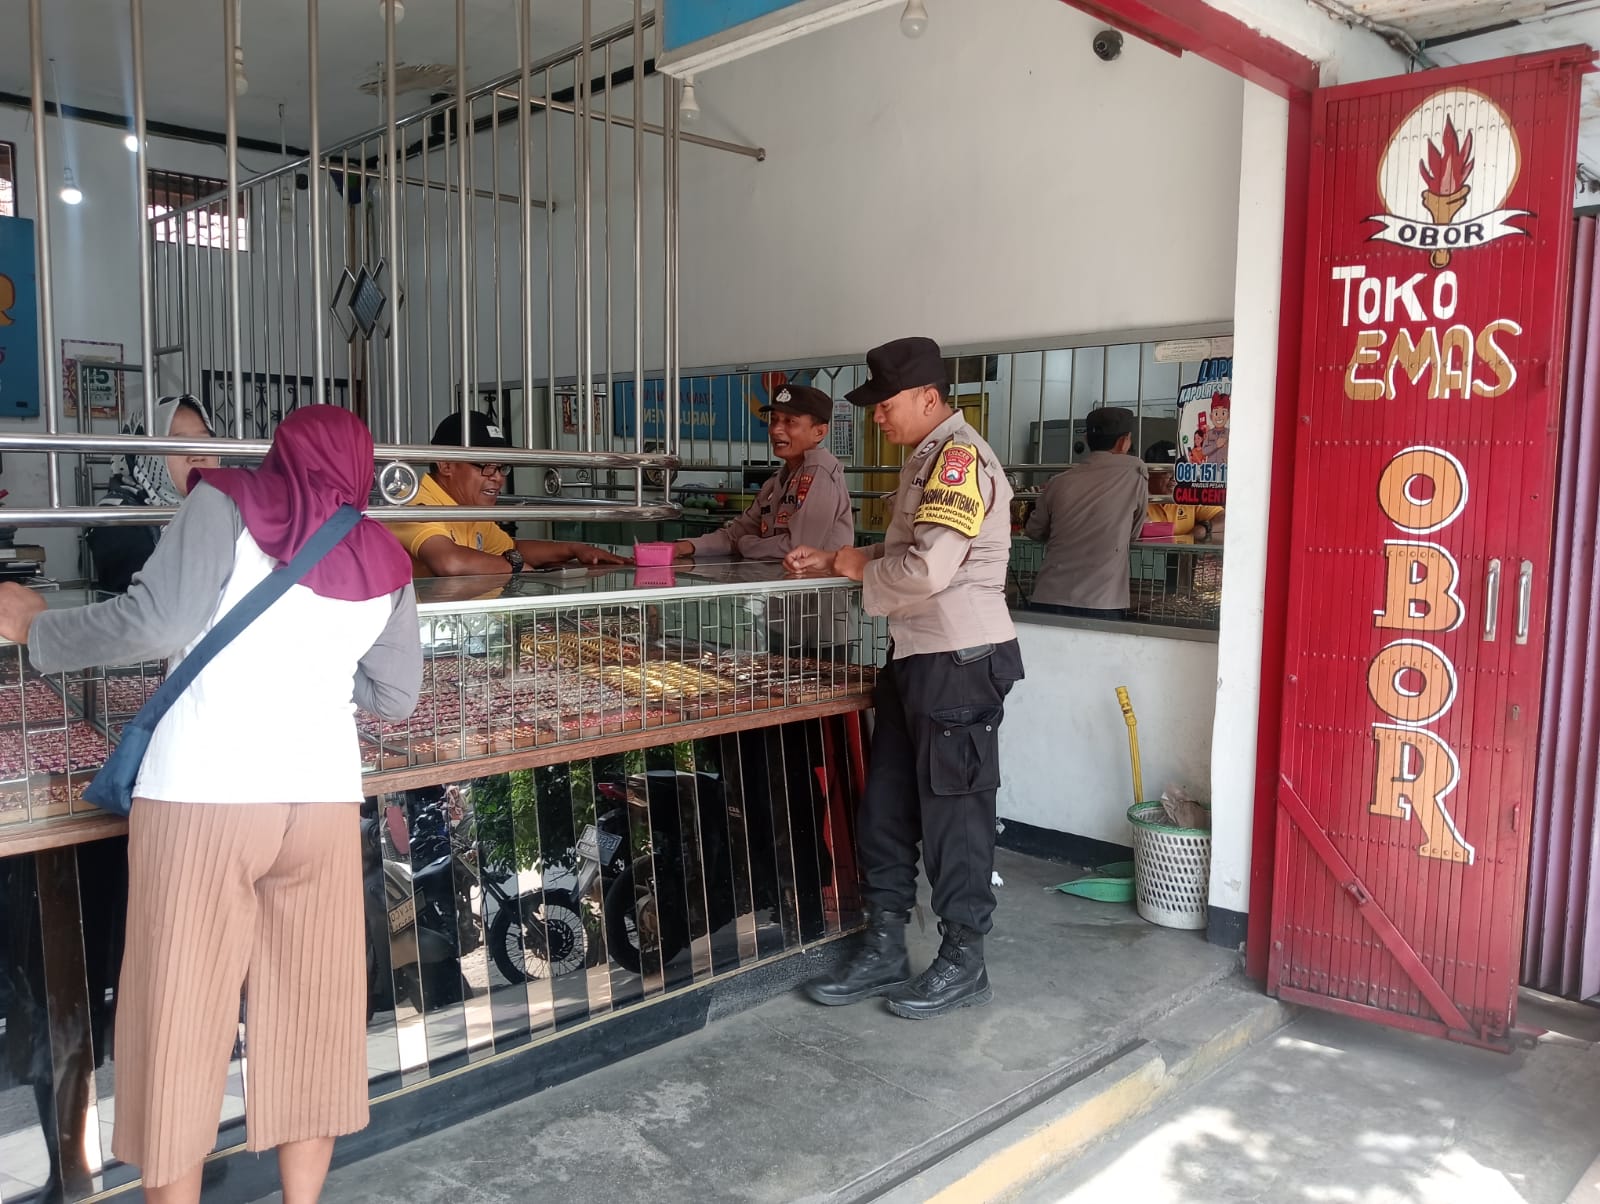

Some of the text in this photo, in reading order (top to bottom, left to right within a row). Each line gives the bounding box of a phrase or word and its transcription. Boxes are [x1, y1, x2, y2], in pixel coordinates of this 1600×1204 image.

[1398, 222, 1485, 247] OBOR
[1332, 265, 1458, 327] TOKO
[1344, 318, 1522, 400] EMAS
[1177, 463, 1196, 481] 081
[1199, 463, 1217, 482] 151
[1175, 487, 1227, 503] CALL CENT
[1367, 445, 1475, 865] OBOR
